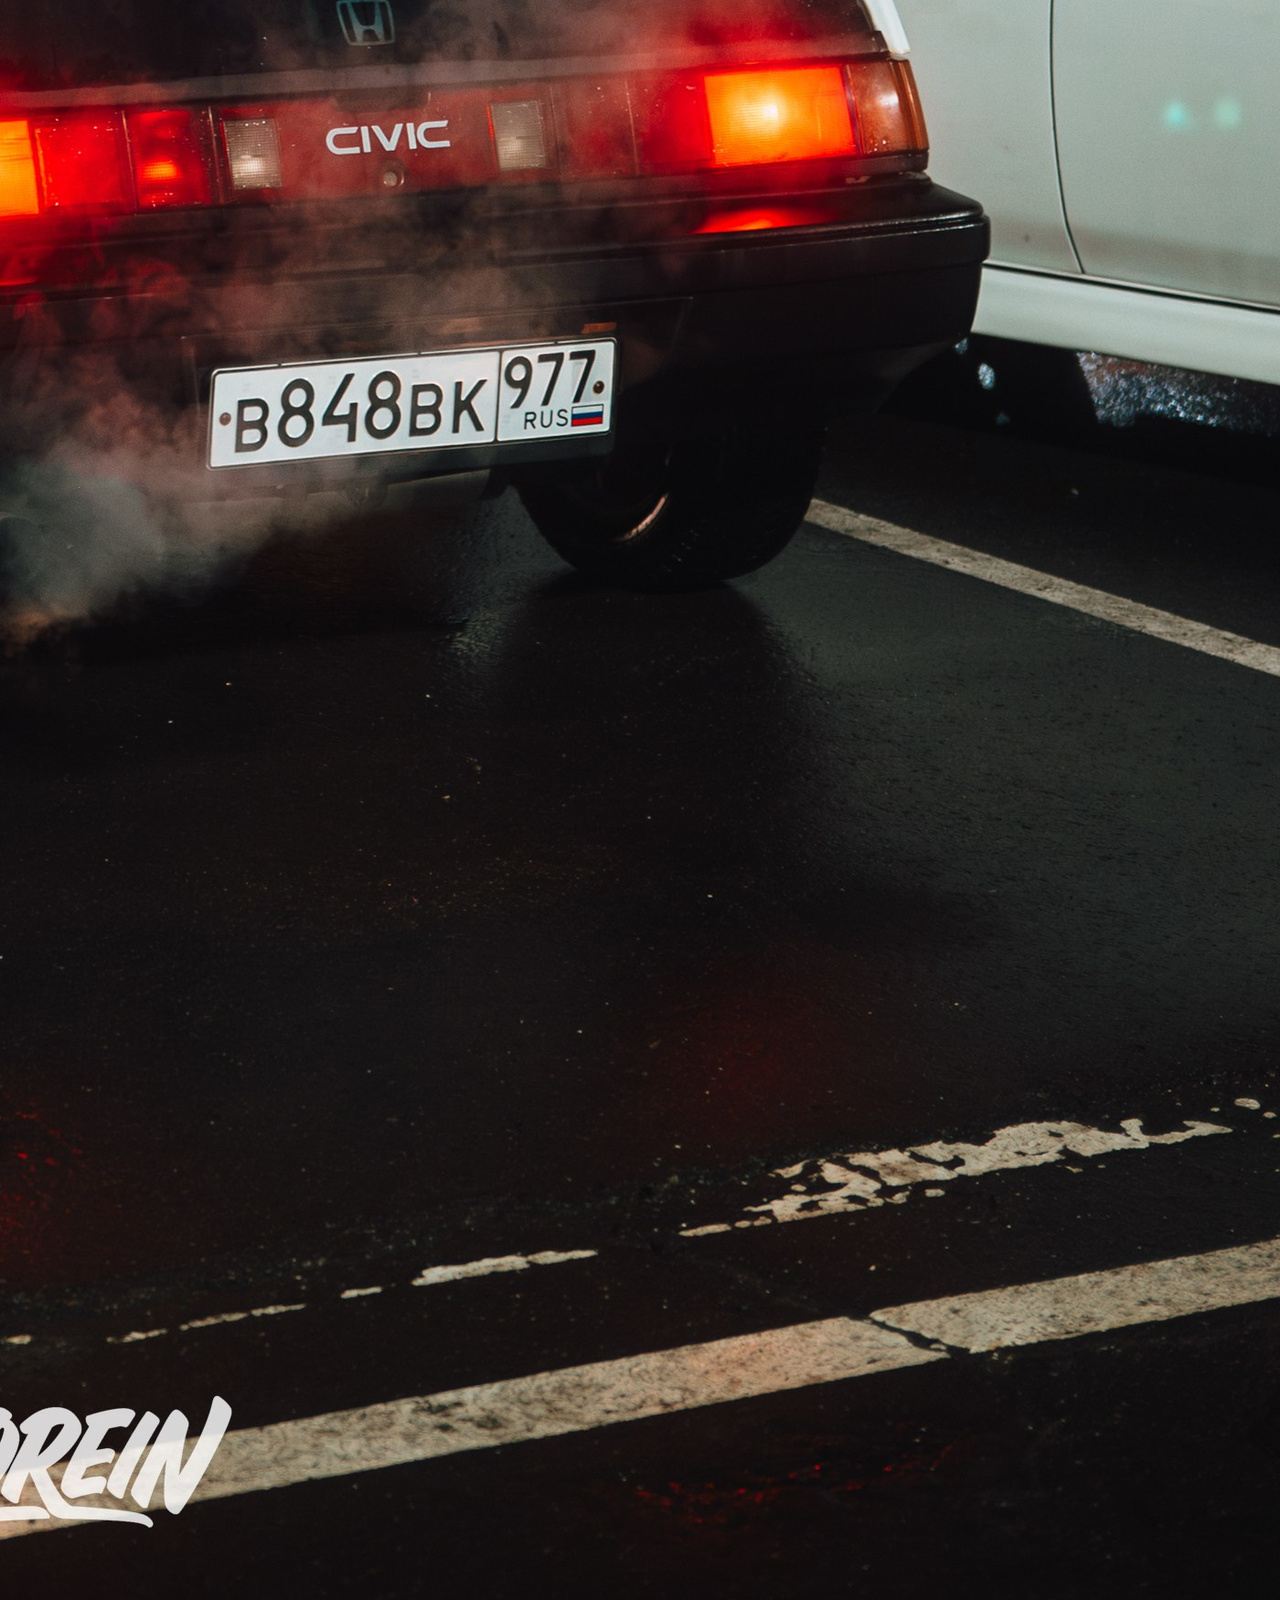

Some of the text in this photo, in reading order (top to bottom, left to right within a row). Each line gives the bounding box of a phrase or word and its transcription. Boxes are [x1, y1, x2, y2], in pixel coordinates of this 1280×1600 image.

[325, 119, 451, 155] CIVIC
[503, 349, 597, 409] 977
[523, 408, 569, 430] RUS
